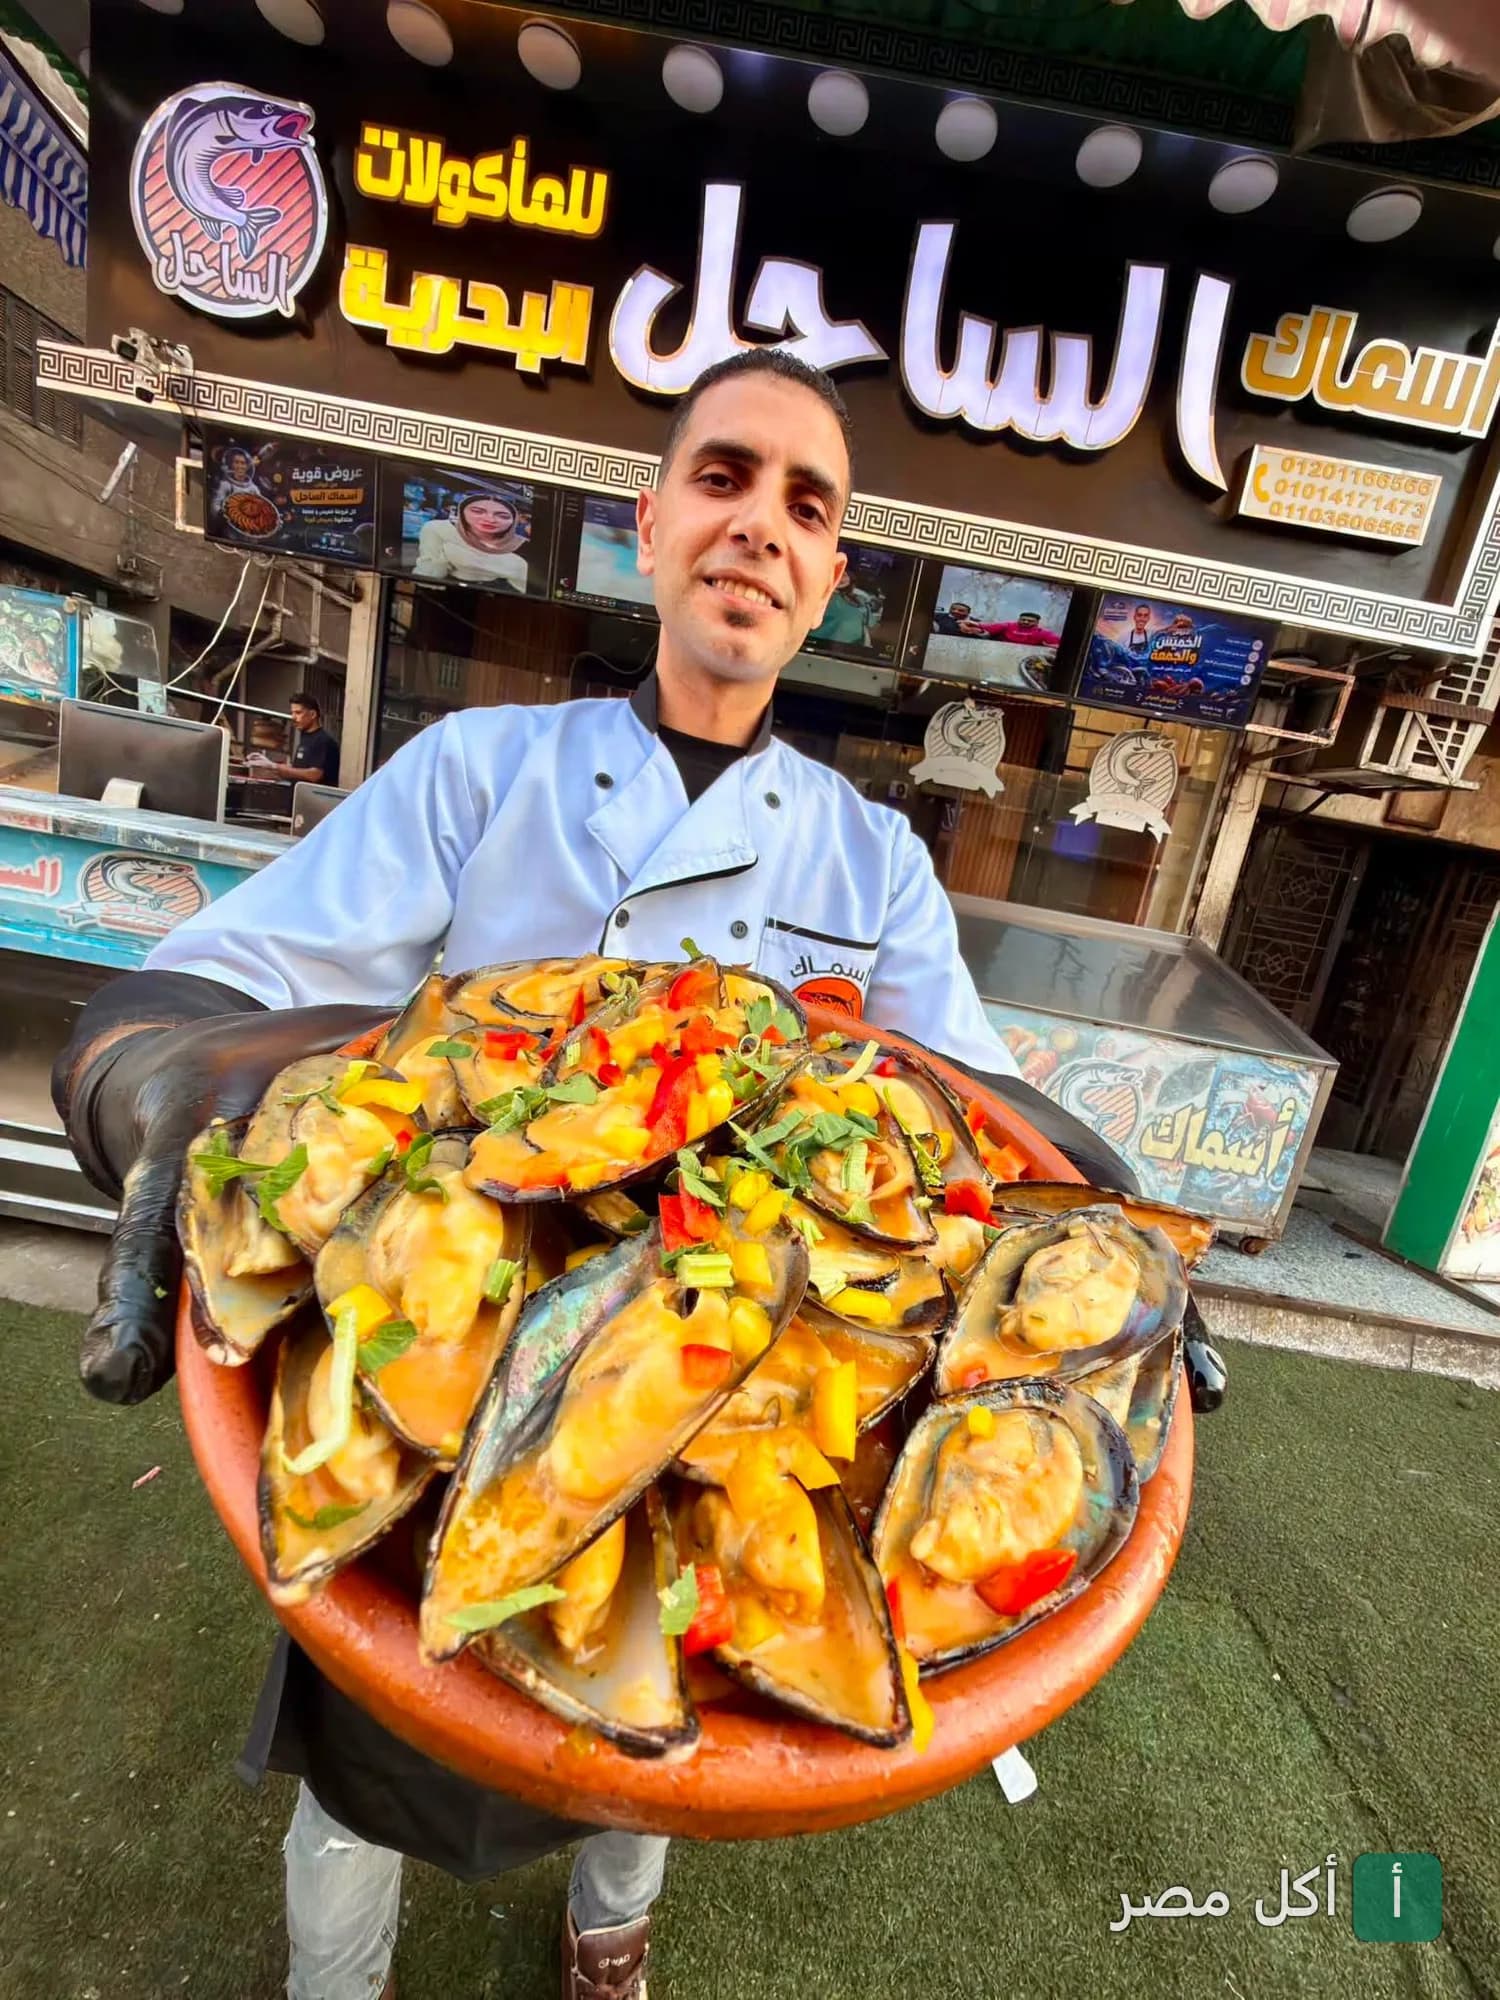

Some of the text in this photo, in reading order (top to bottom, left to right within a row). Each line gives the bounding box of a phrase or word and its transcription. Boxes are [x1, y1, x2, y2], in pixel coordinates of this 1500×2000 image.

[355, 123, 608, 237] للمأكولات
[156, 229, 289, 312] الساحل
[339, 244, 594, 373] البحرية
[608, 180, 1233, 491] الساحل
[292, 465, 363, 483] عروض قوية
[1274, 479, 1426, 519] 01014171473
[1281, 455, 1433, 496] 01201166566
[1155, 635, 1202, 651] الخميس
[1138, 1096, 1298, 1179] أسماك
